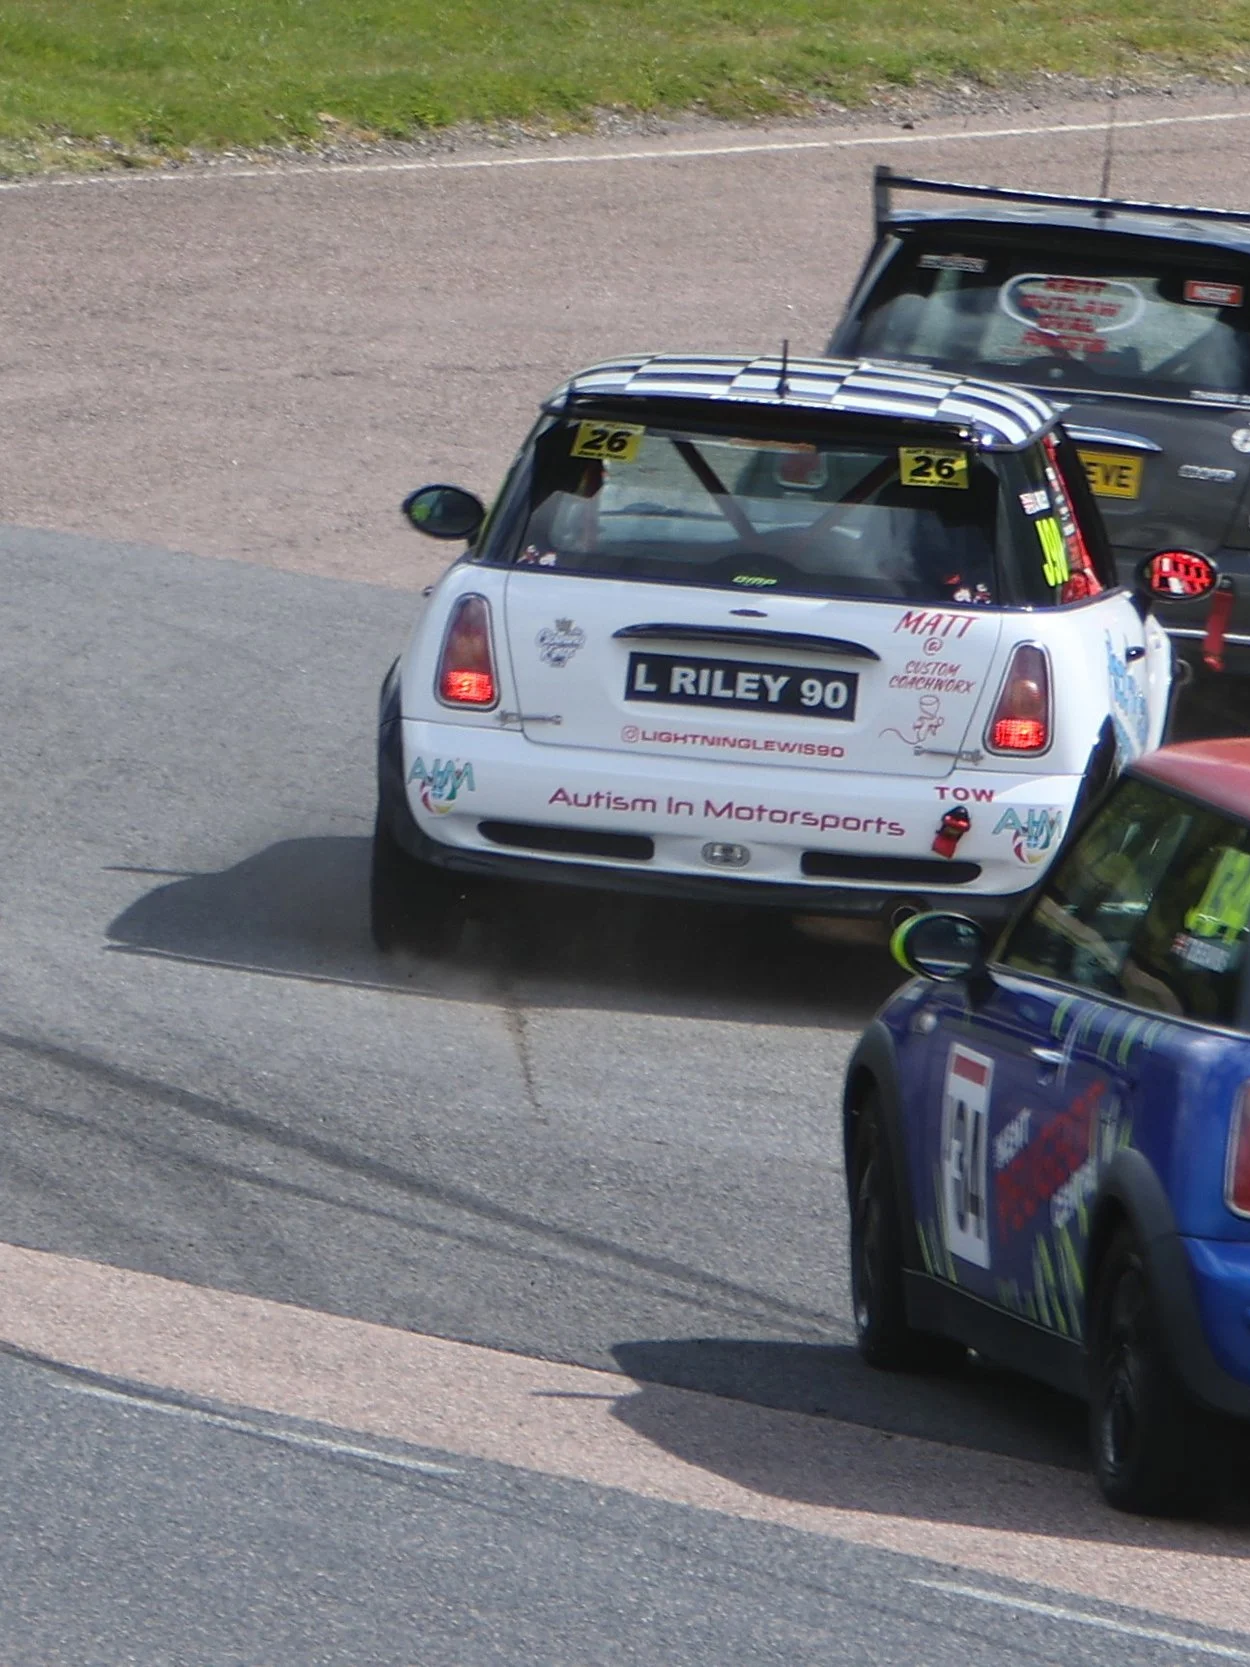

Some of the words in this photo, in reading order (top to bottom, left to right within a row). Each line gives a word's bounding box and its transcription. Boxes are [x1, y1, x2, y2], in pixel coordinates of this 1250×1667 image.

[581, 428, 632, 452] 26
[910, 455, 956, 479] 26
[892, 610, 980, 639] MATT
[923, 636, 944, 656] @
[905, 660, 962, 676] CUSTOM
[634, 663, 657, 691] L
[669, 666, 790, 702] RILEY
[799, 678, 849, 710] 90
[888, 675, 977, 694] COACHWORX
[641, 730, 845, 758] LIGHTNINGLEWIS90
[933, 785, 995, 803] TOW
[548, 787, 657, 813] Autism
[665, 796, 694, 816] In
[703, 799, 906, 836] Motorsports
